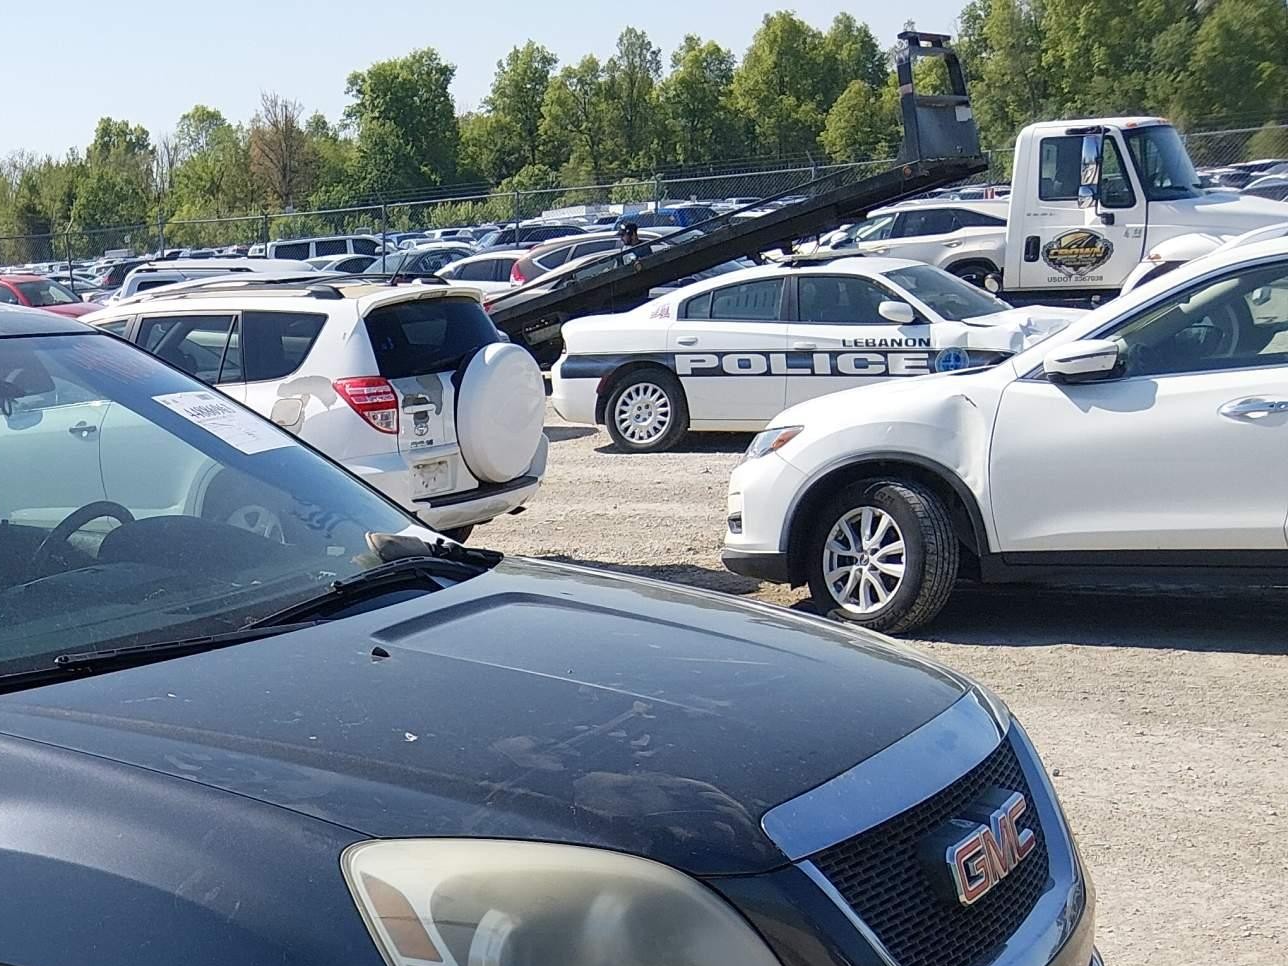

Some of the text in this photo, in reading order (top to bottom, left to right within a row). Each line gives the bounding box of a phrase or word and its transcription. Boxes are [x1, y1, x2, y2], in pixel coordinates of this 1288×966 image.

[842, 338, 930, 348] LEBANON
[674, 353, 929, 375] POLICE
[946, 791, 1036, 905] GMC
